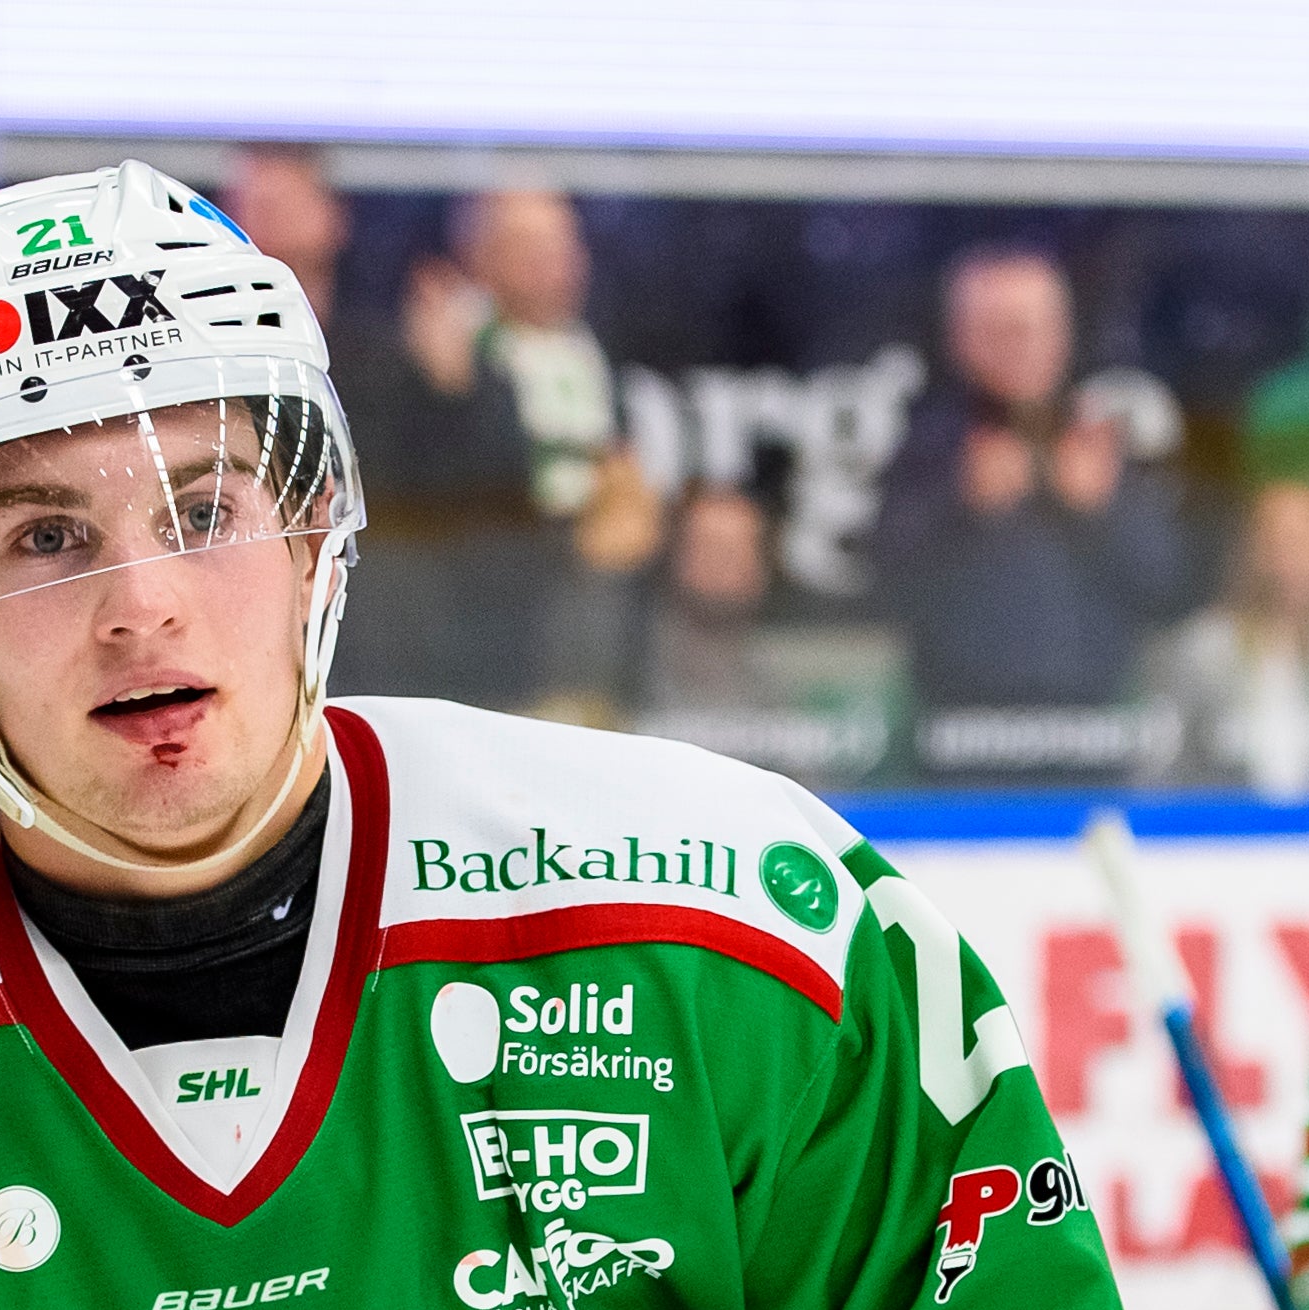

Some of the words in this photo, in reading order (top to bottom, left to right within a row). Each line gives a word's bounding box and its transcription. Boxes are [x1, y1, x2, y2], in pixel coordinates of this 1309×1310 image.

[17, 215, 94, 257] 21
[24, 269, 177, 345] IXX
[35, 328, 183, 369] IT-PARTNER
[409, 828, 740, 898] Backahill
[505, 982, 634, 1037] Solid
[176, 1067, 261, 1104] SHL
[501, 1041, 675, 1092] Försäkring
